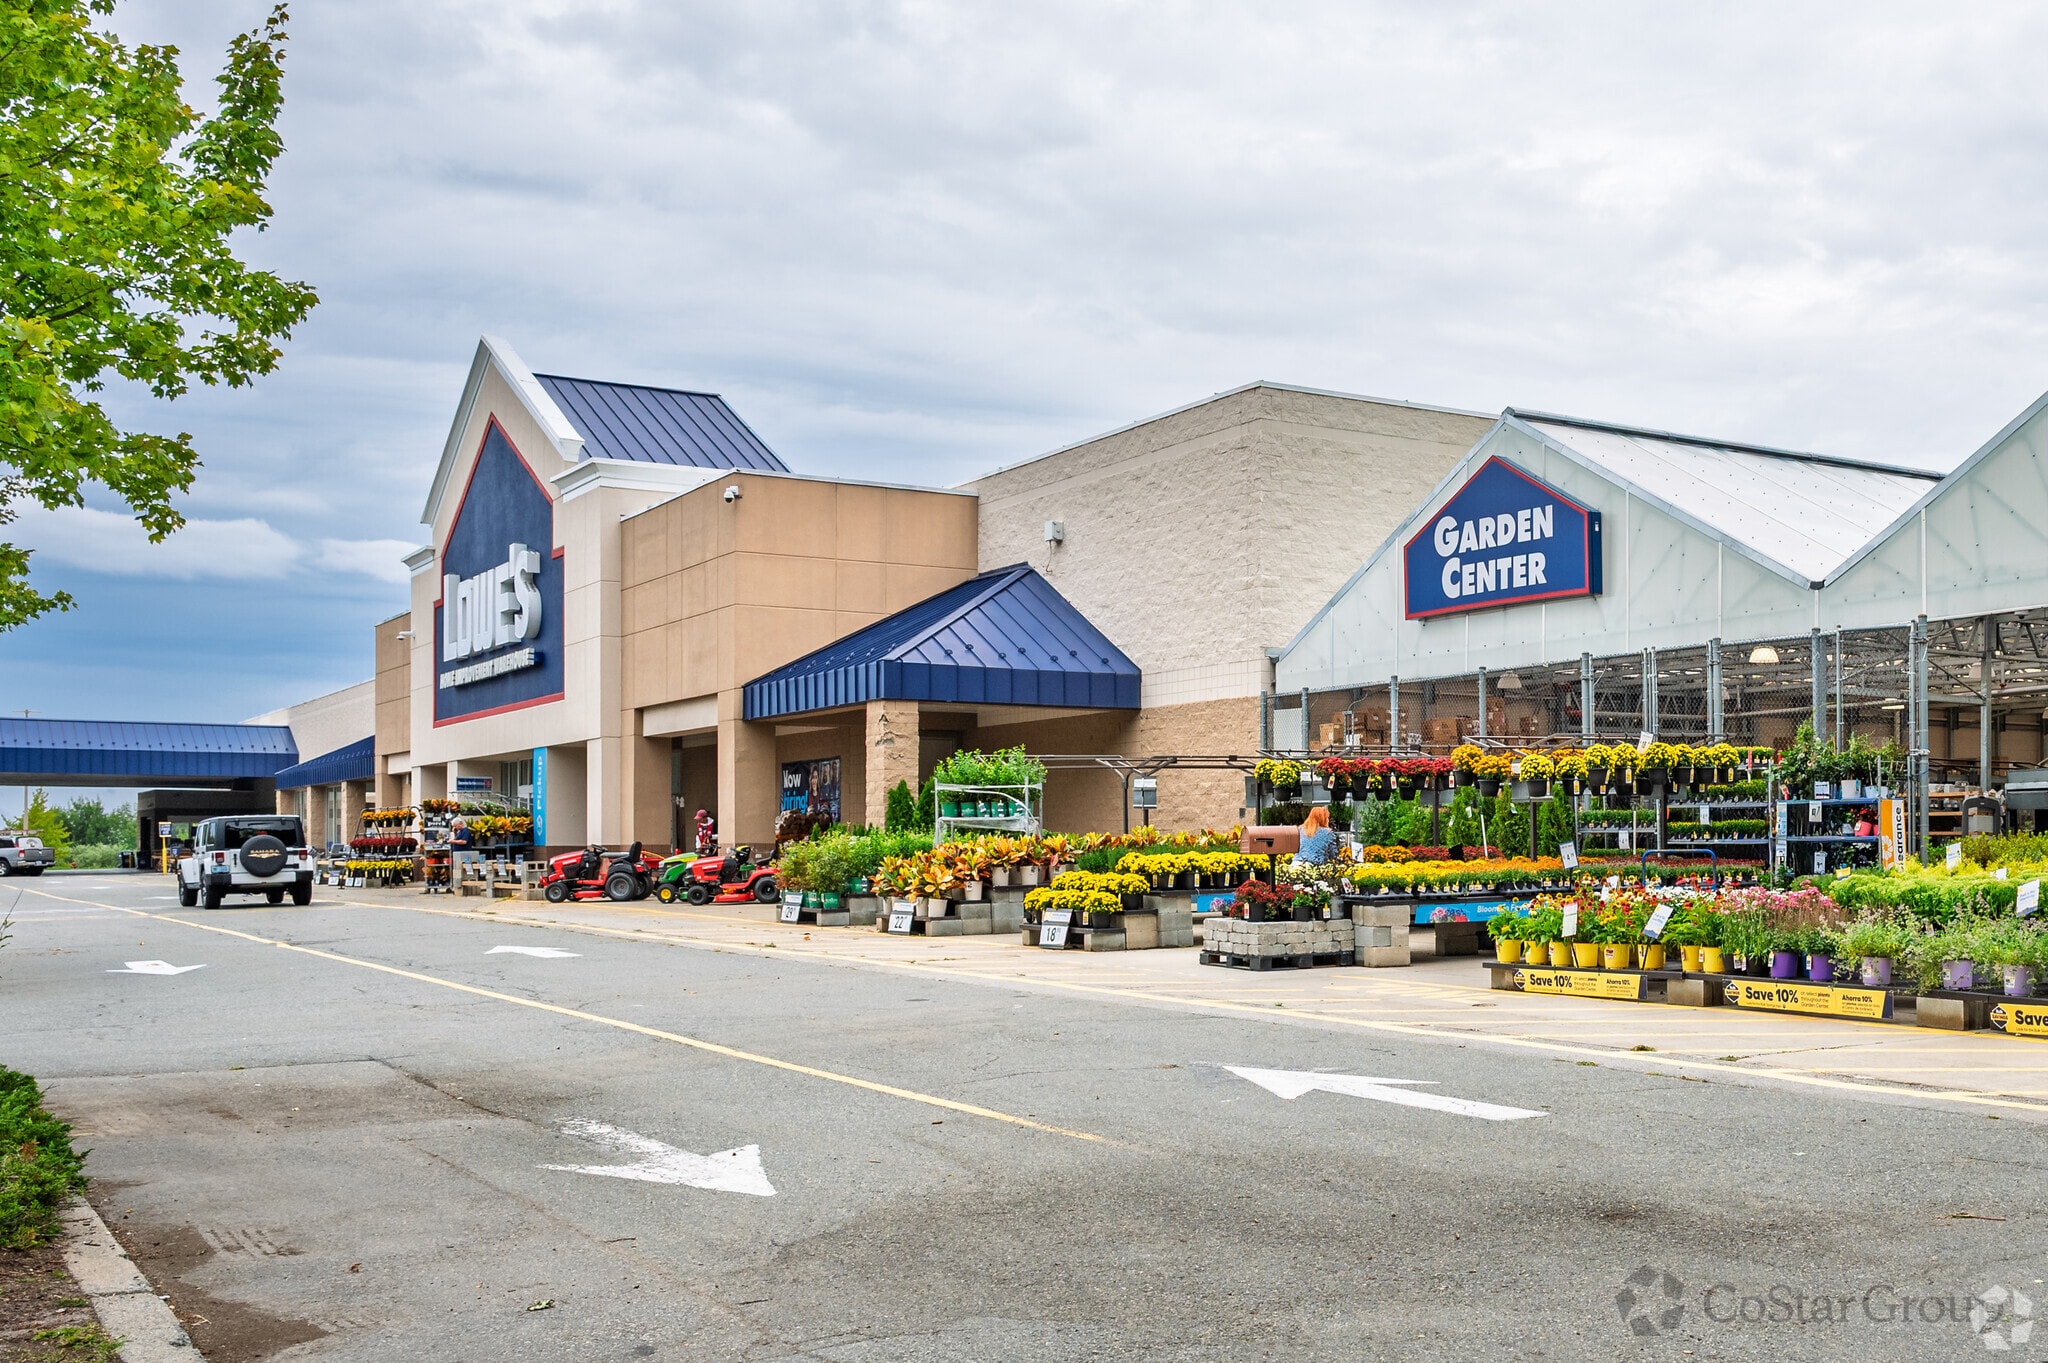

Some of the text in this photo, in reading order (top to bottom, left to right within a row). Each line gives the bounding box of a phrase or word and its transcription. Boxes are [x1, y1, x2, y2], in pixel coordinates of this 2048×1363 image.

[1434, 504, 1553, 557] GARDEN
[1441, 552, 1547, 598] CENTER
[443, 543, 542, 662] LOWE'S
[783, 770, 801, 788] Now
[783, 790, 808, 814] hiring!
[1896, 807, 1904, 870] earance
[1530, 974, 1572, 988] Save 10%
[1745, 986, 1799, 1004] Save 10%
[1862, 995, 1873, 1003] 10%
[2015, 1010, 2048, 1026] Save
